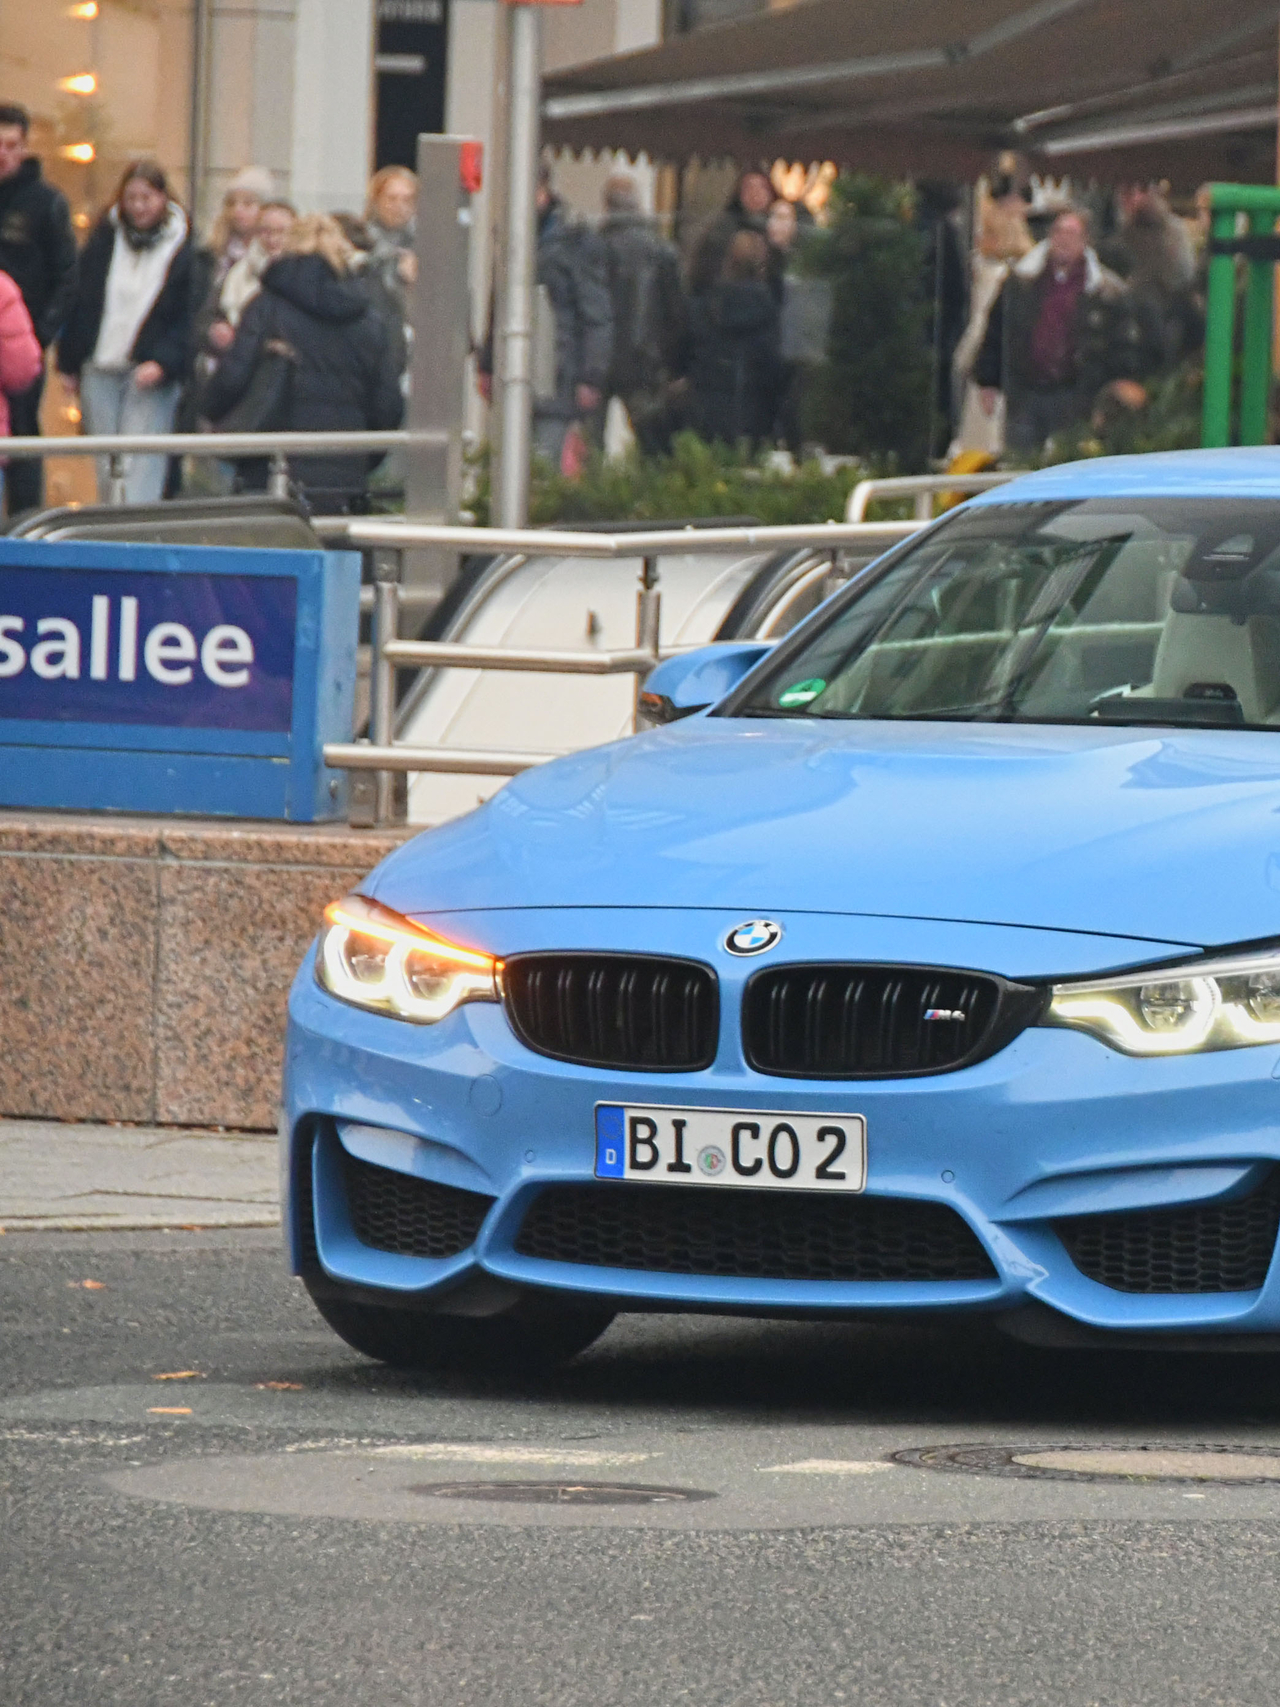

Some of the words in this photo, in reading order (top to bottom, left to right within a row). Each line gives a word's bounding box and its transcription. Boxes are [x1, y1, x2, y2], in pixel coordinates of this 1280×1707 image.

[0, 594, 255, 688] sallee
[605, 1148, 617, 1165] D
[628, 1115, 692, 1174] BI
